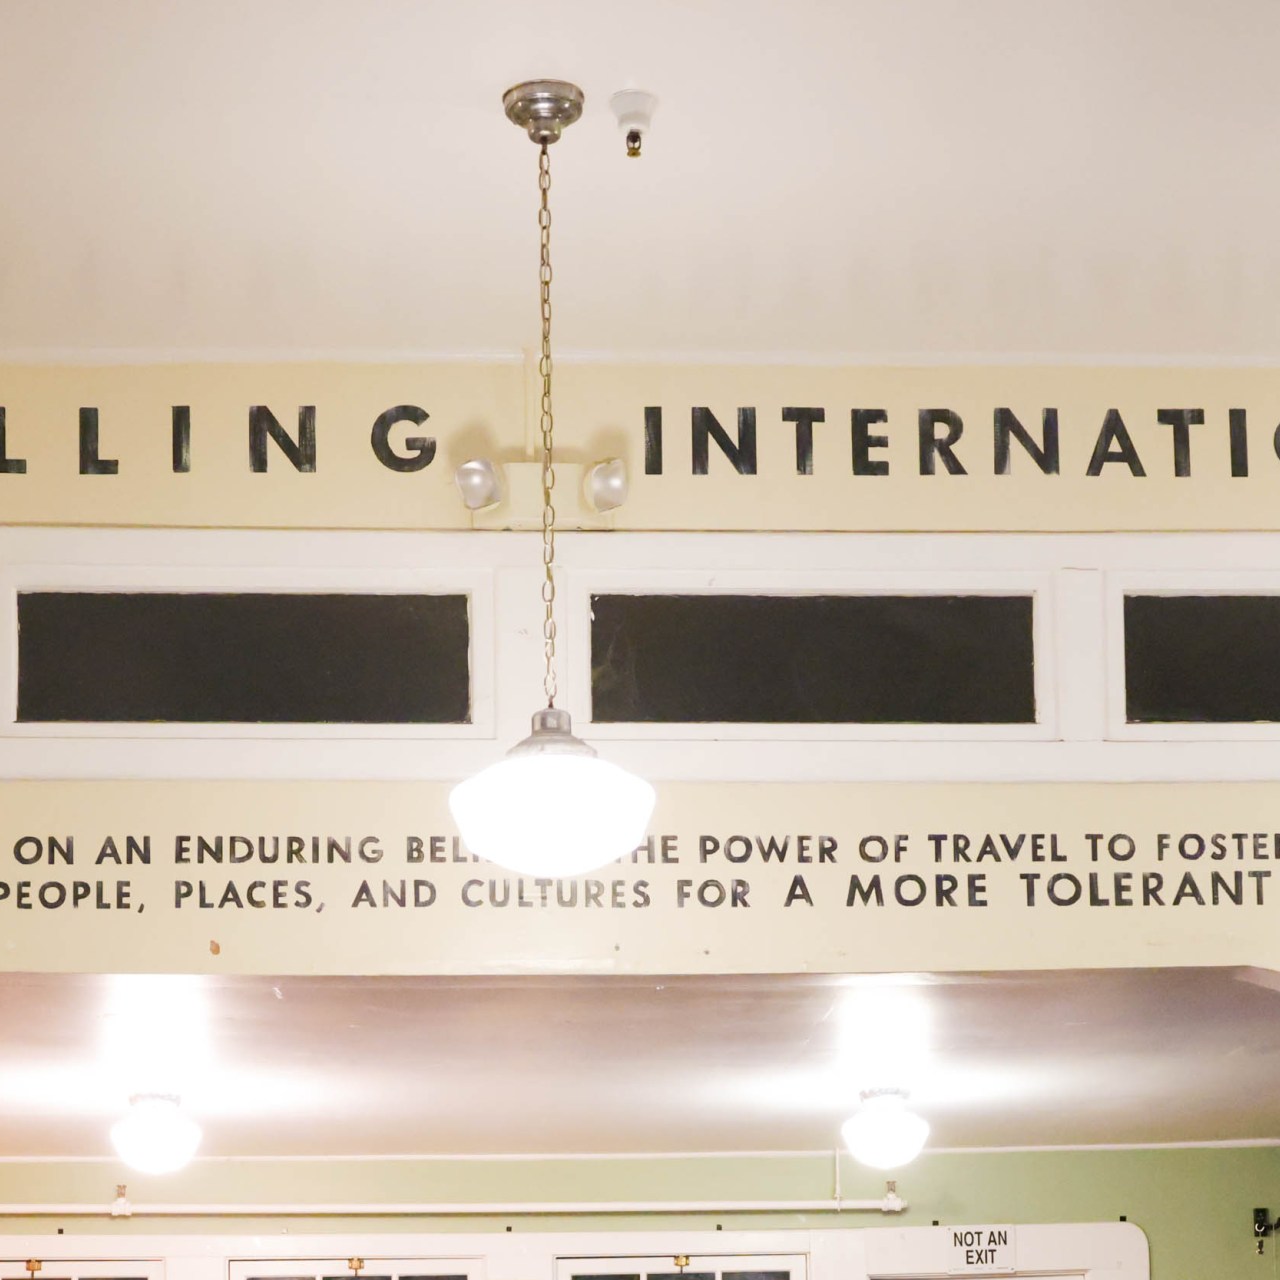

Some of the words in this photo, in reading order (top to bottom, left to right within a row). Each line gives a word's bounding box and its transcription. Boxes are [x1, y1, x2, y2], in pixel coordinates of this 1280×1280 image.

[12, 836, 74, 866] ON
[94, 835, 151, 865] AN
[174, 835, 384, 865] ENDURING
[616, 835, 679, 864] HE
[698, 835, 838, 864] POWER
[859, 834, 909, 863] OF
[927, 833, 1067, 863] TRAVEL
[1084, 833, 1136, 862] TO
[174, 879, 325, 913] PLACES,
[351, 879, 436, 908] AND
[461, 878, 651, 908] CULTURES
[677, 879, 751, 908] FOR
[784, 874, 814, 907] A
[846, 873, 988, 907] MORE
[1018, 870, 1272, 907] TOLERANT
[953, 1231, 983, 1247] NOT
[988, 1230, 1007, 1246] AN
[966, 1249, 997, 1264] EXIT
